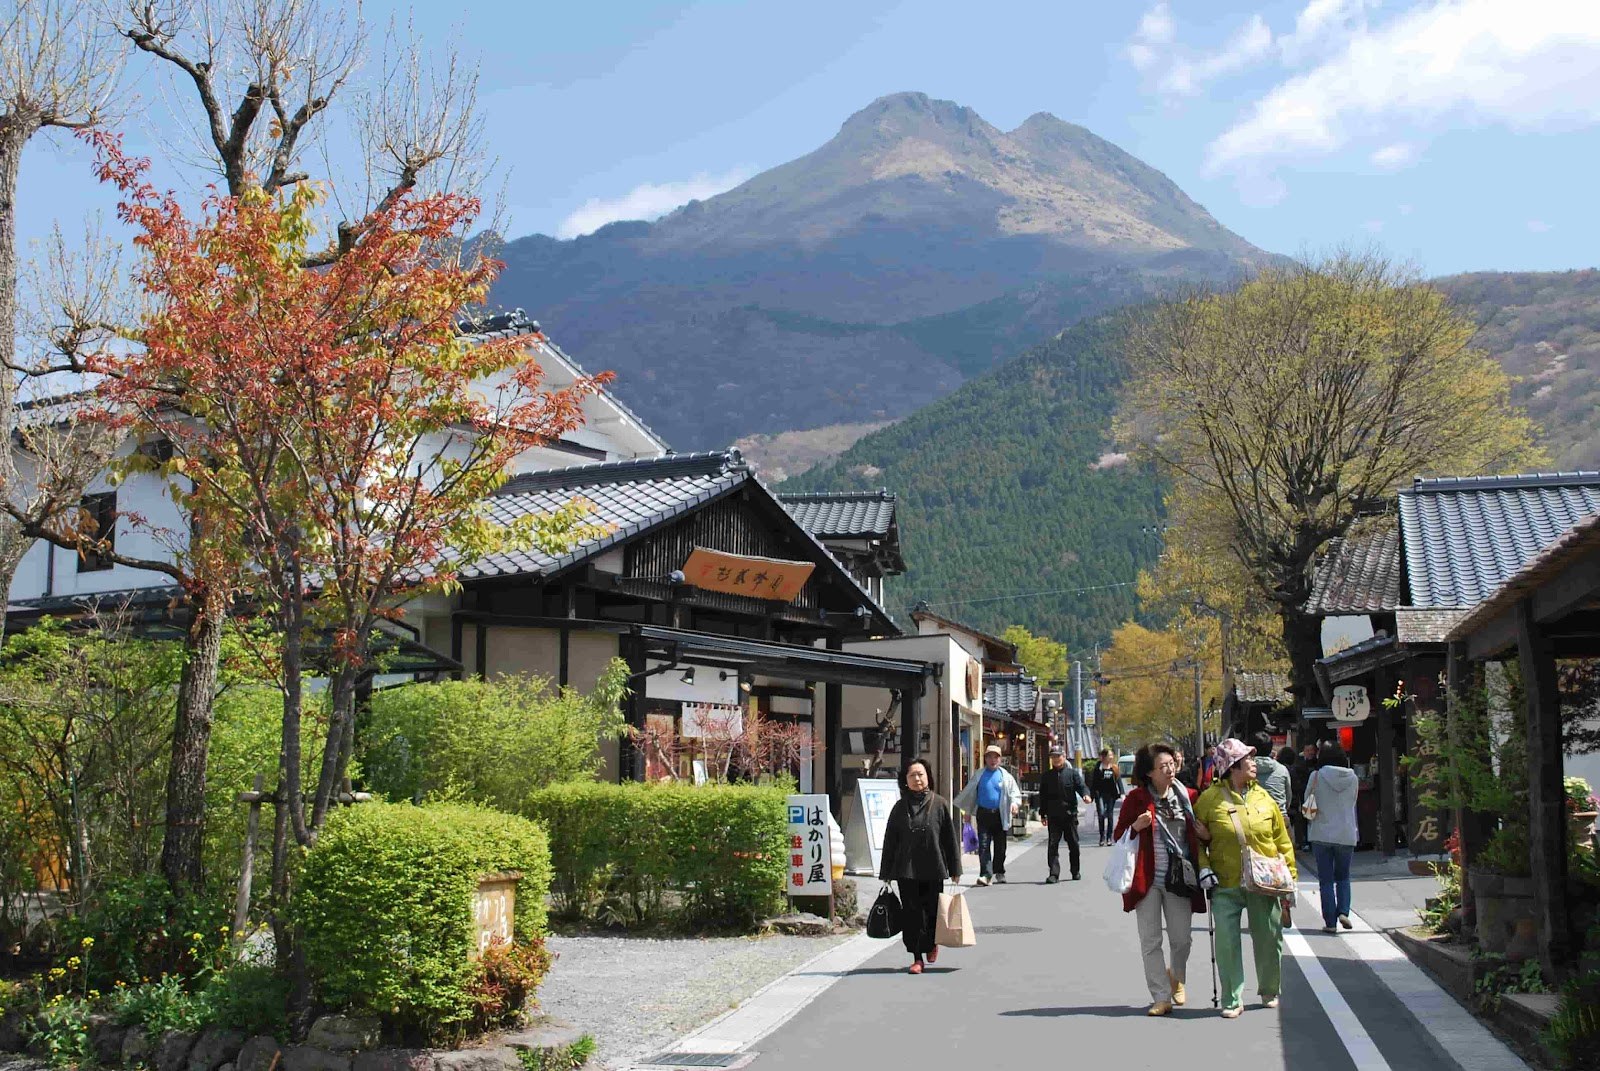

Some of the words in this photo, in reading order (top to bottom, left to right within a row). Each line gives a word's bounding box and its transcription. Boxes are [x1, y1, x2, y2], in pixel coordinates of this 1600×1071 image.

[1345, 691, 1359, 718] ぷりん
[790, 807, 803, 823] P
[791, 835, 804, 887] 駐車場
[807, 805, 826, 884] はかり屋
